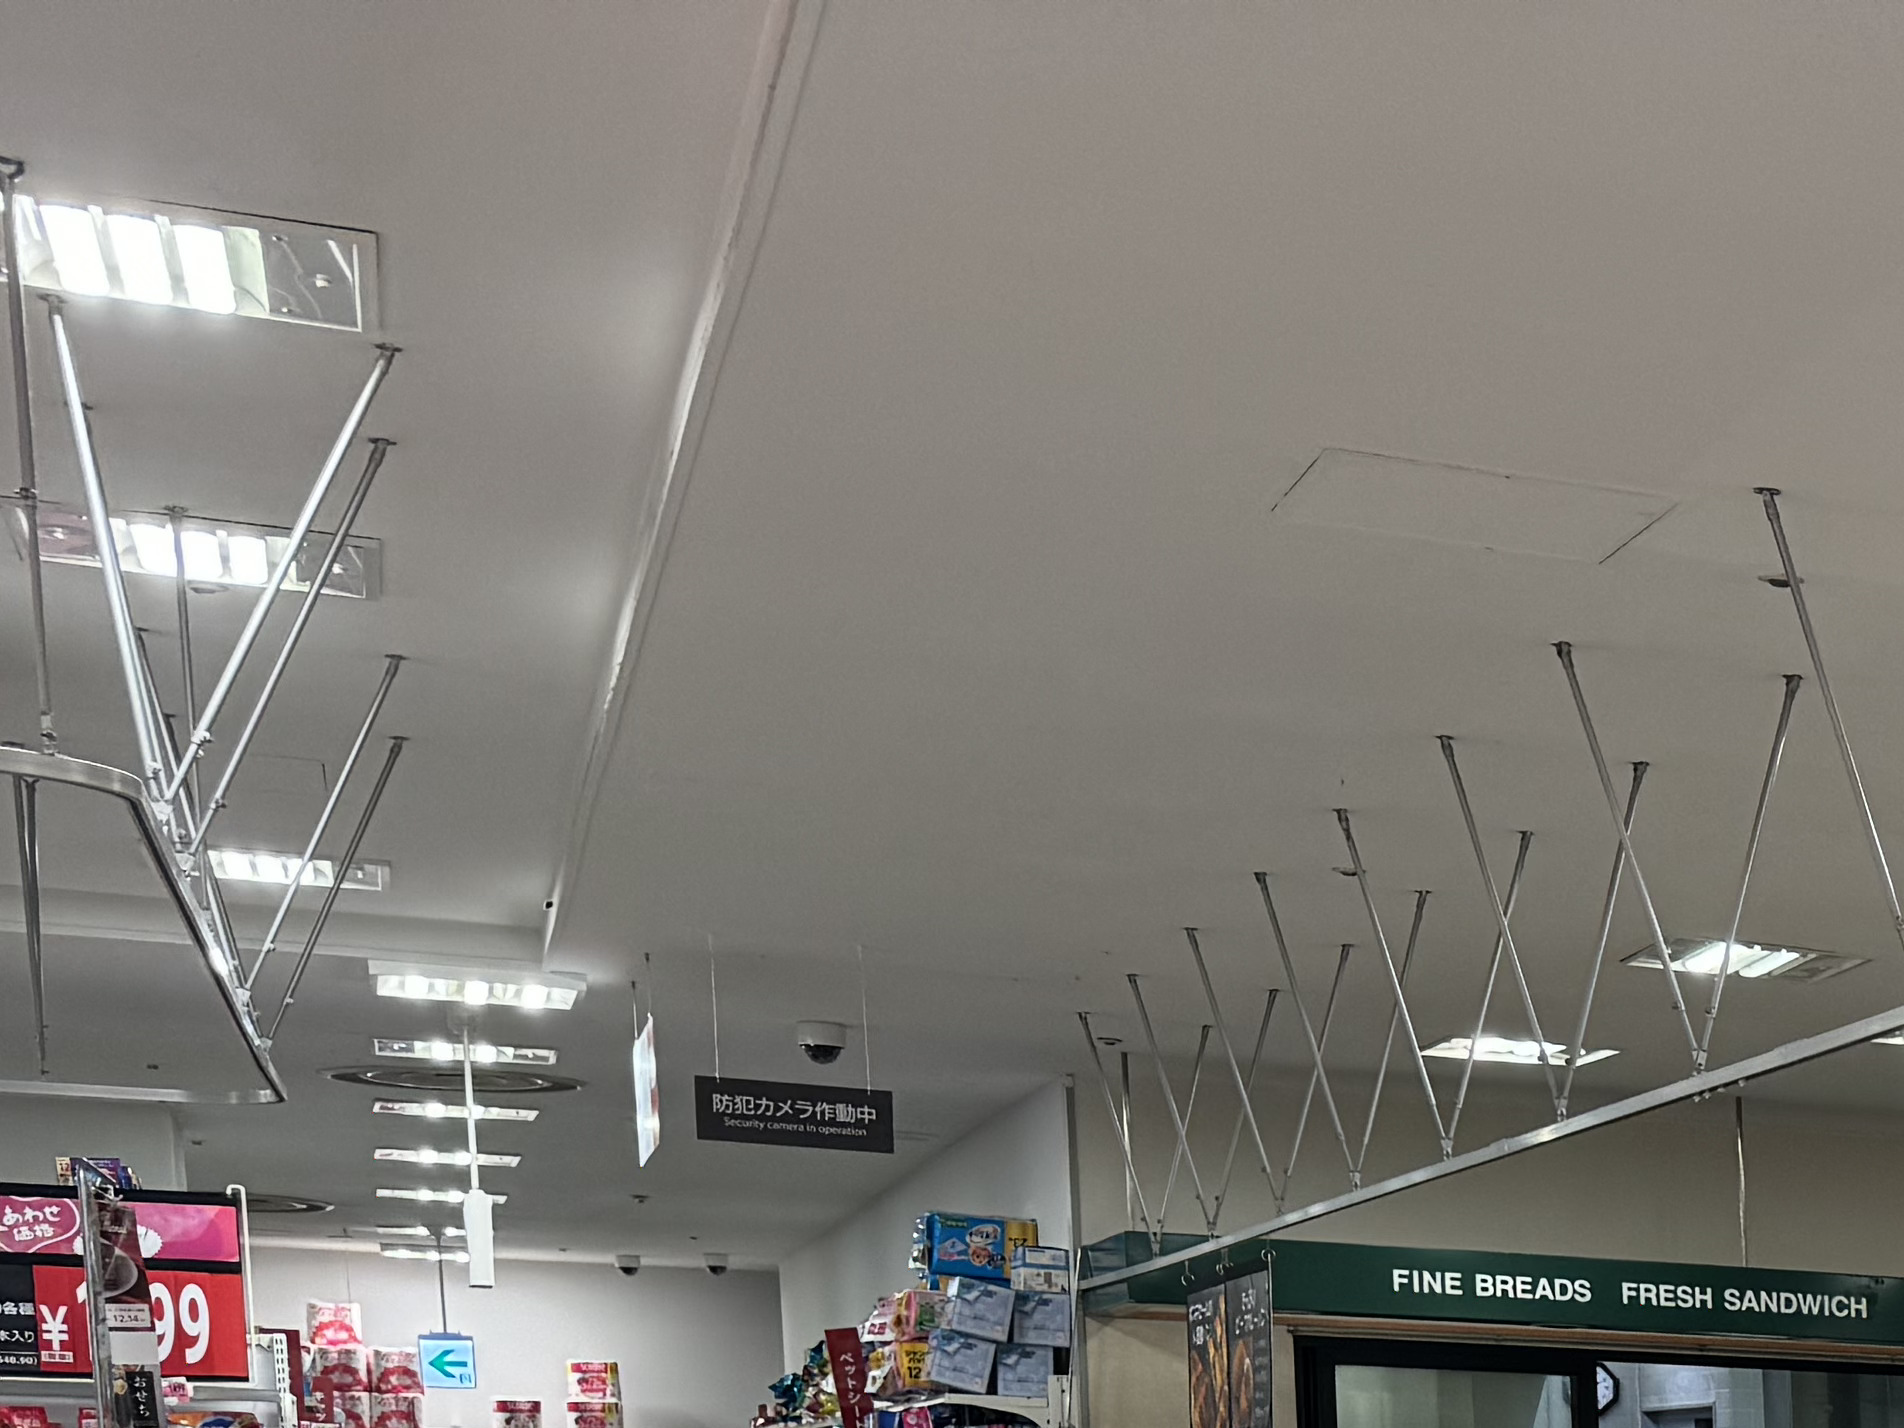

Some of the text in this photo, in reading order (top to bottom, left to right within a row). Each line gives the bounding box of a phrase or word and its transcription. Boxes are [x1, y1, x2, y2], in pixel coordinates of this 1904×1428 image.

[712, 1093, 877, 1124] 防犯カメラ作動中
[724, 1116, 867, 1138] Security camera in operation
[1392, 1268, 1869, 1320] FINE BREADS FRESH SANDWICH
[132, 1375, 151, 1418] おせち
